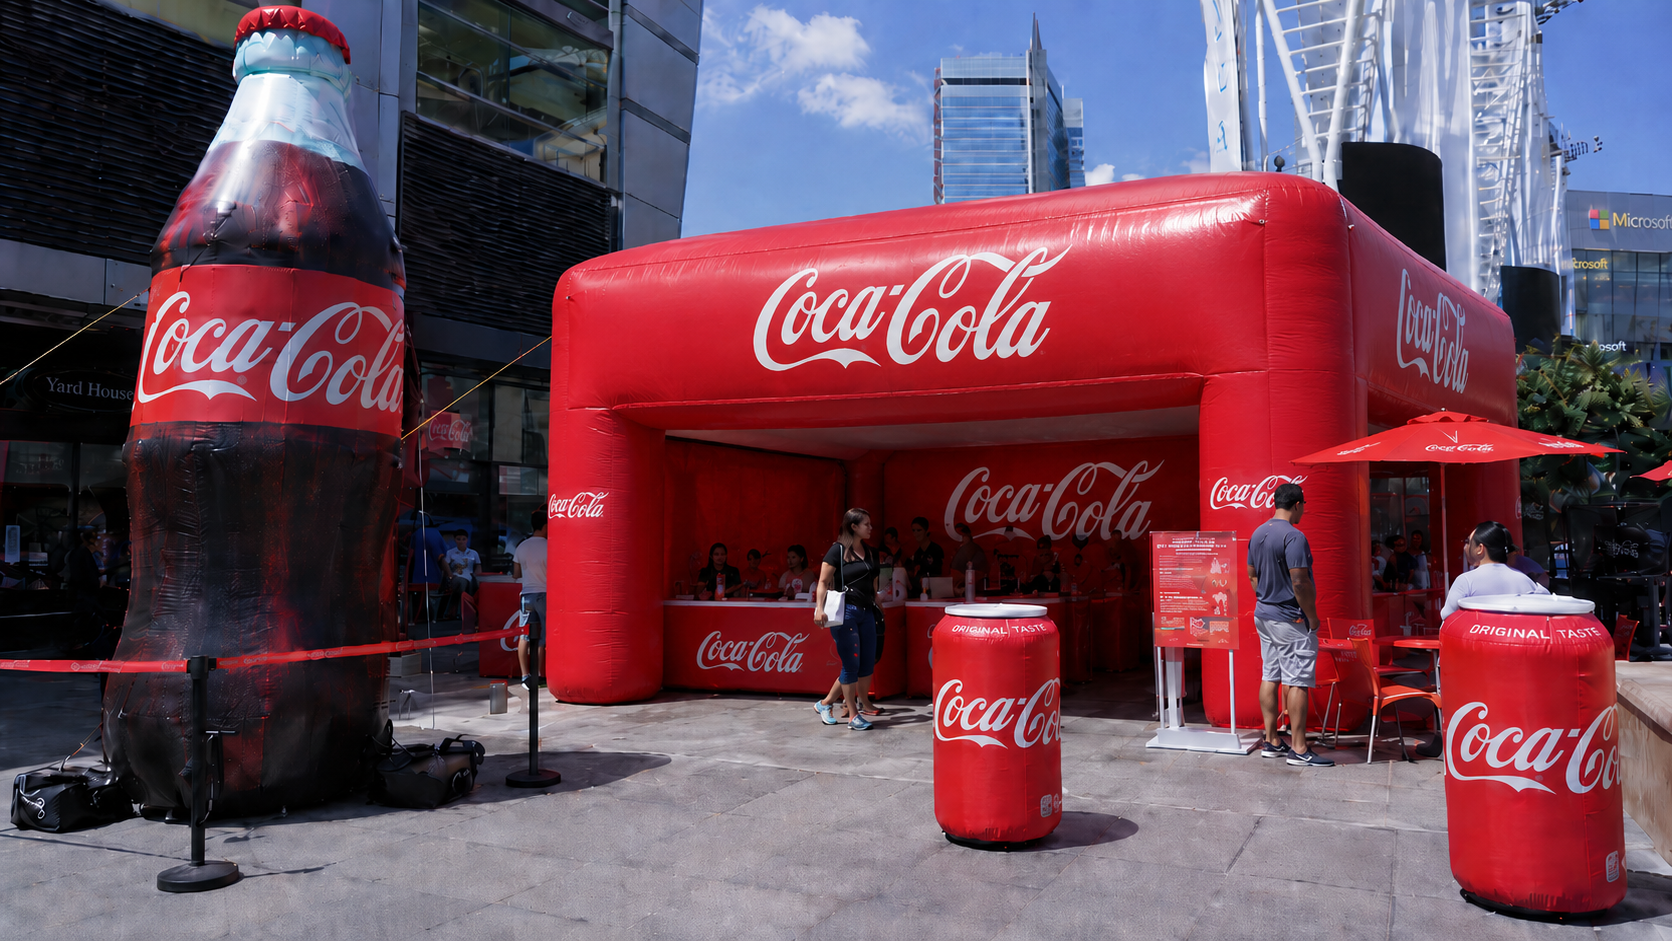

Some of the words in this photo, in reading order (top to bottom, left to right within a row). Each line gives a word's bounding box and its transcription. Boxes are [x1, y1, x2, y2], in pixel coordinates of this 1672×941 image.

[1562, 257, 1608, 269] crosoft
[753, 244, 1073, 371] Coca-Cola
[1396, 268, 1469, 394] Coca-Cola
[137, 291, 404, 413] Coca-Cola
[46, 376, 83, 395] Yard
[87, 382, 134, 401] House
[548, 491, 609, 519] Coca-Cola
[944, 459, 1165, 542] Coca-Cola
[1210, 474, 1308, 510] Coca-Co
[951, 624, 1008, 635] ORIGINAL
[1011, 623, 1047, 634] TASTE
[1469, 624, 1550, 640] ORIGINAL
[1556, 626, 1602, 639] TASTE
[696, 630, 811, 673] Coca-Cola
[934, 677, 1061, 749] Coca-Col
